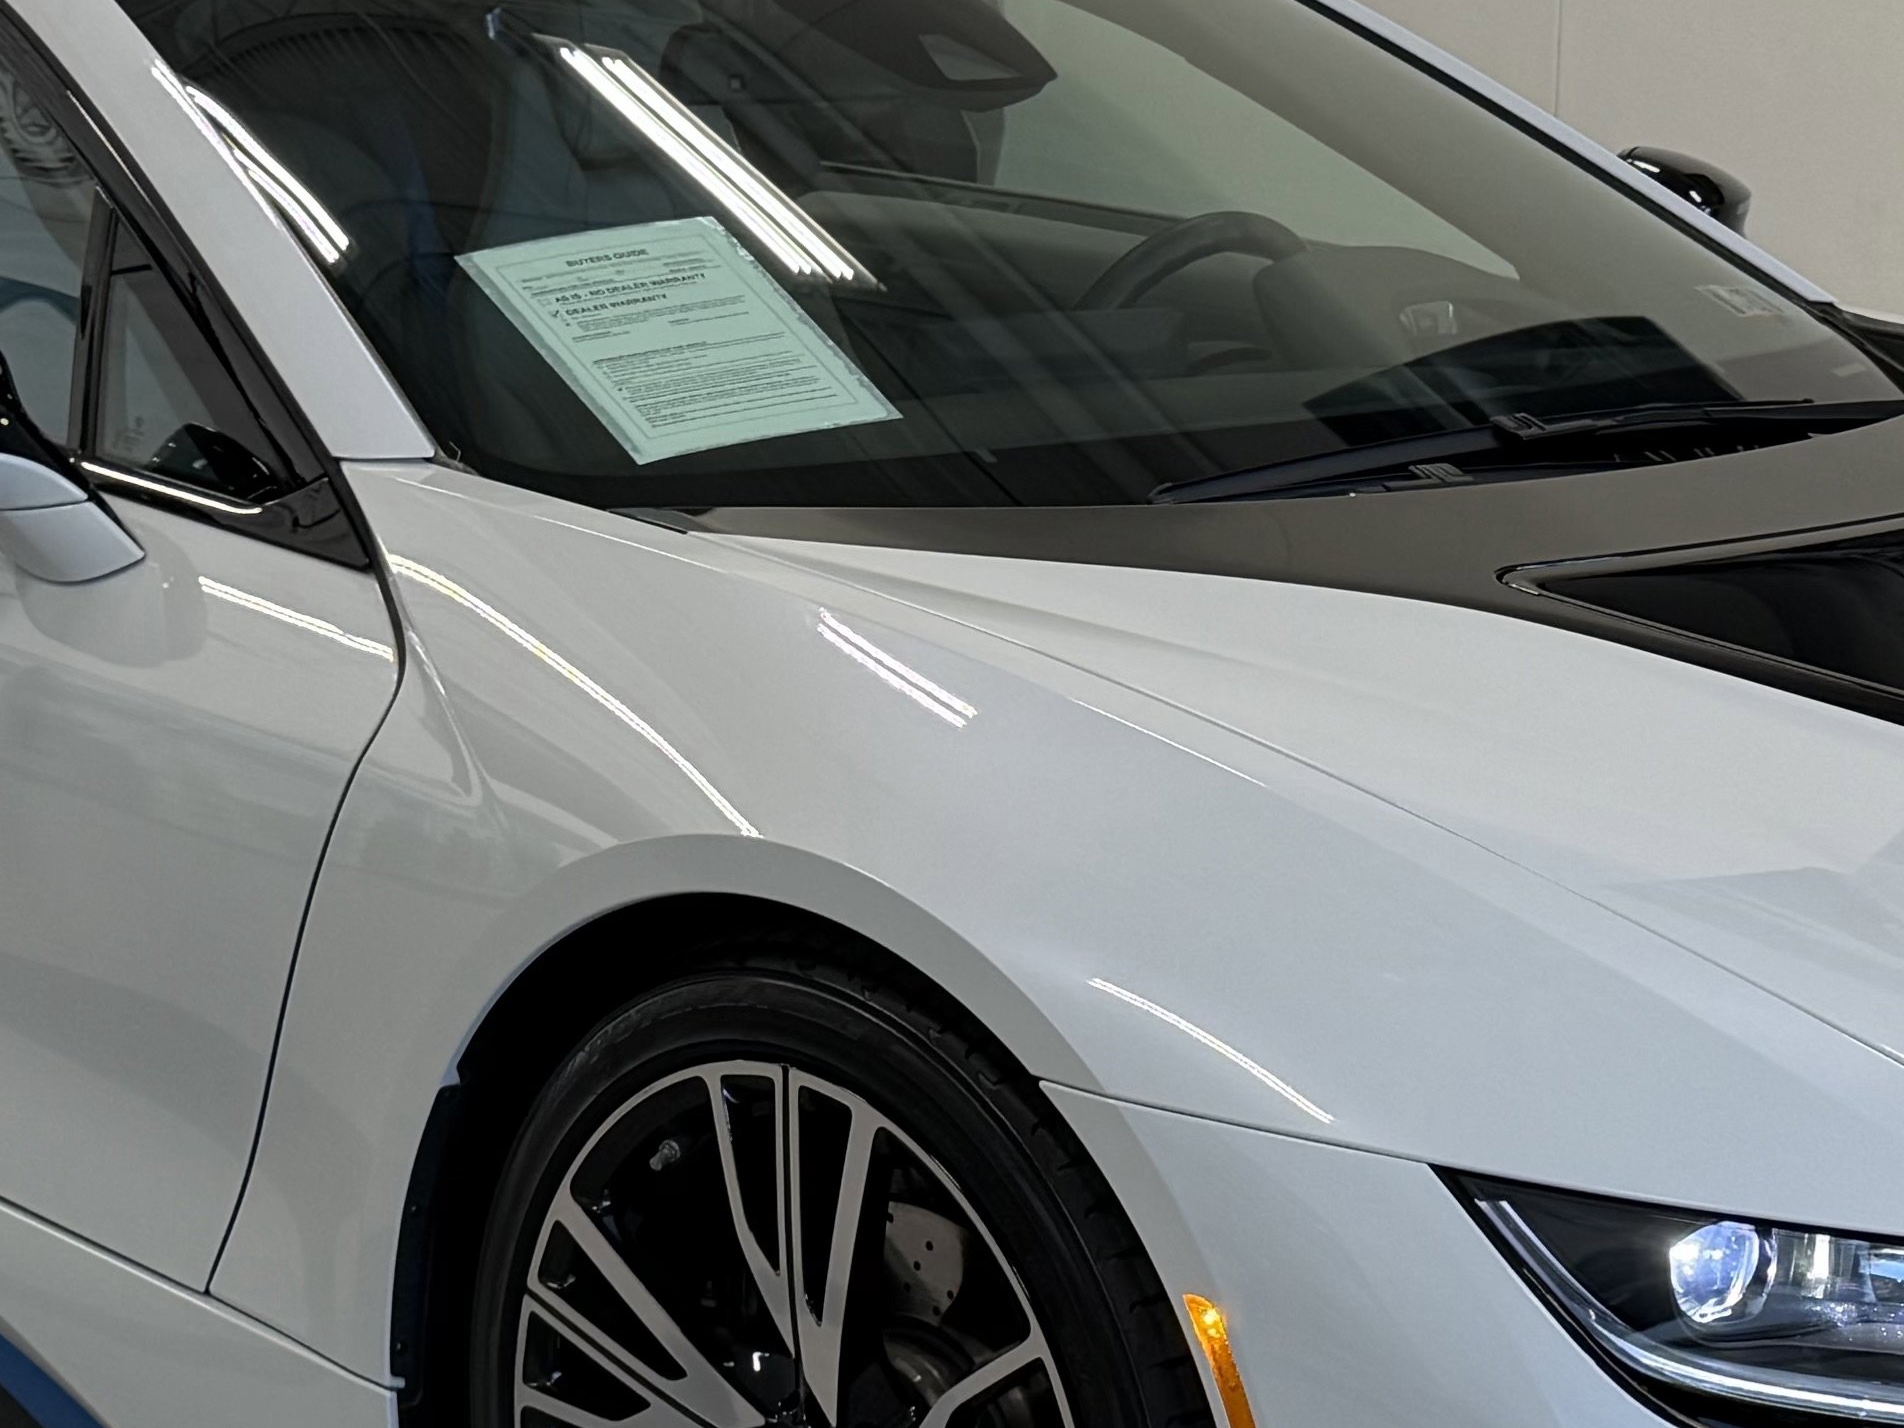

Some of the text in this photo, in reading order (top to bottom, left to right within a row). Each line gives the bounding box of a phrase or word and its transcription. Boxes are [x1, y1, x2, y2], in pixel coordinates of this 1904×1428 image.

[566, 248, 650, 267] BUYERS GUIDE
[555, 295, 570, 303] AS
[588, 288, 606, 296] NO
[606, 282, 648, 293] DEALER
[649, 272, 706, 286] WARRANTY
[565, 293, 667, 316] DEALER WARRANTY
